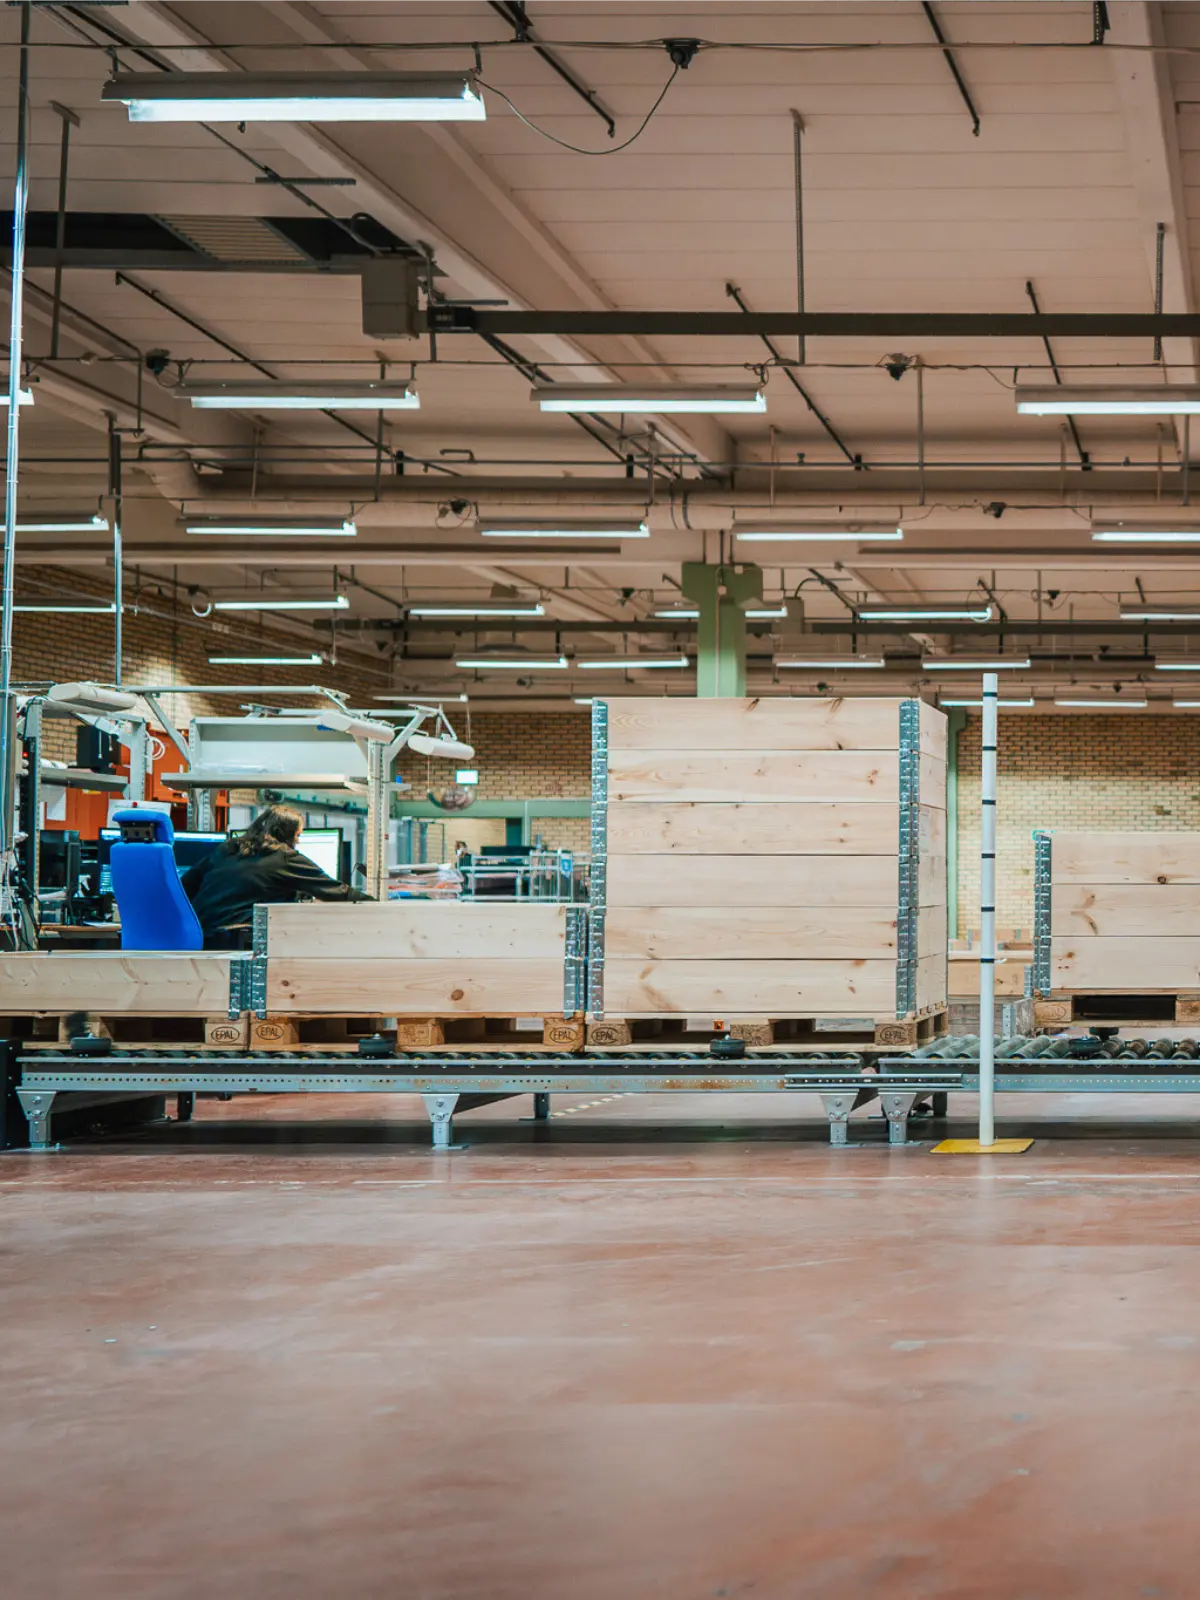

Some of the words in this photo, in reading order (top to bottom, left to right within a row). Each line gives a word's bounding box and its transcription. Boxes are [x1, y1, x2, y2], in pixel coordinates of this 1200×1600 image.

[215, 1030, 235, 1040] EPAL
[260, 1026, 280, 1037] EPAL
[553, 1031, 573, 1041] EPAL
[595, 1031, 613, 1041] EPAL
